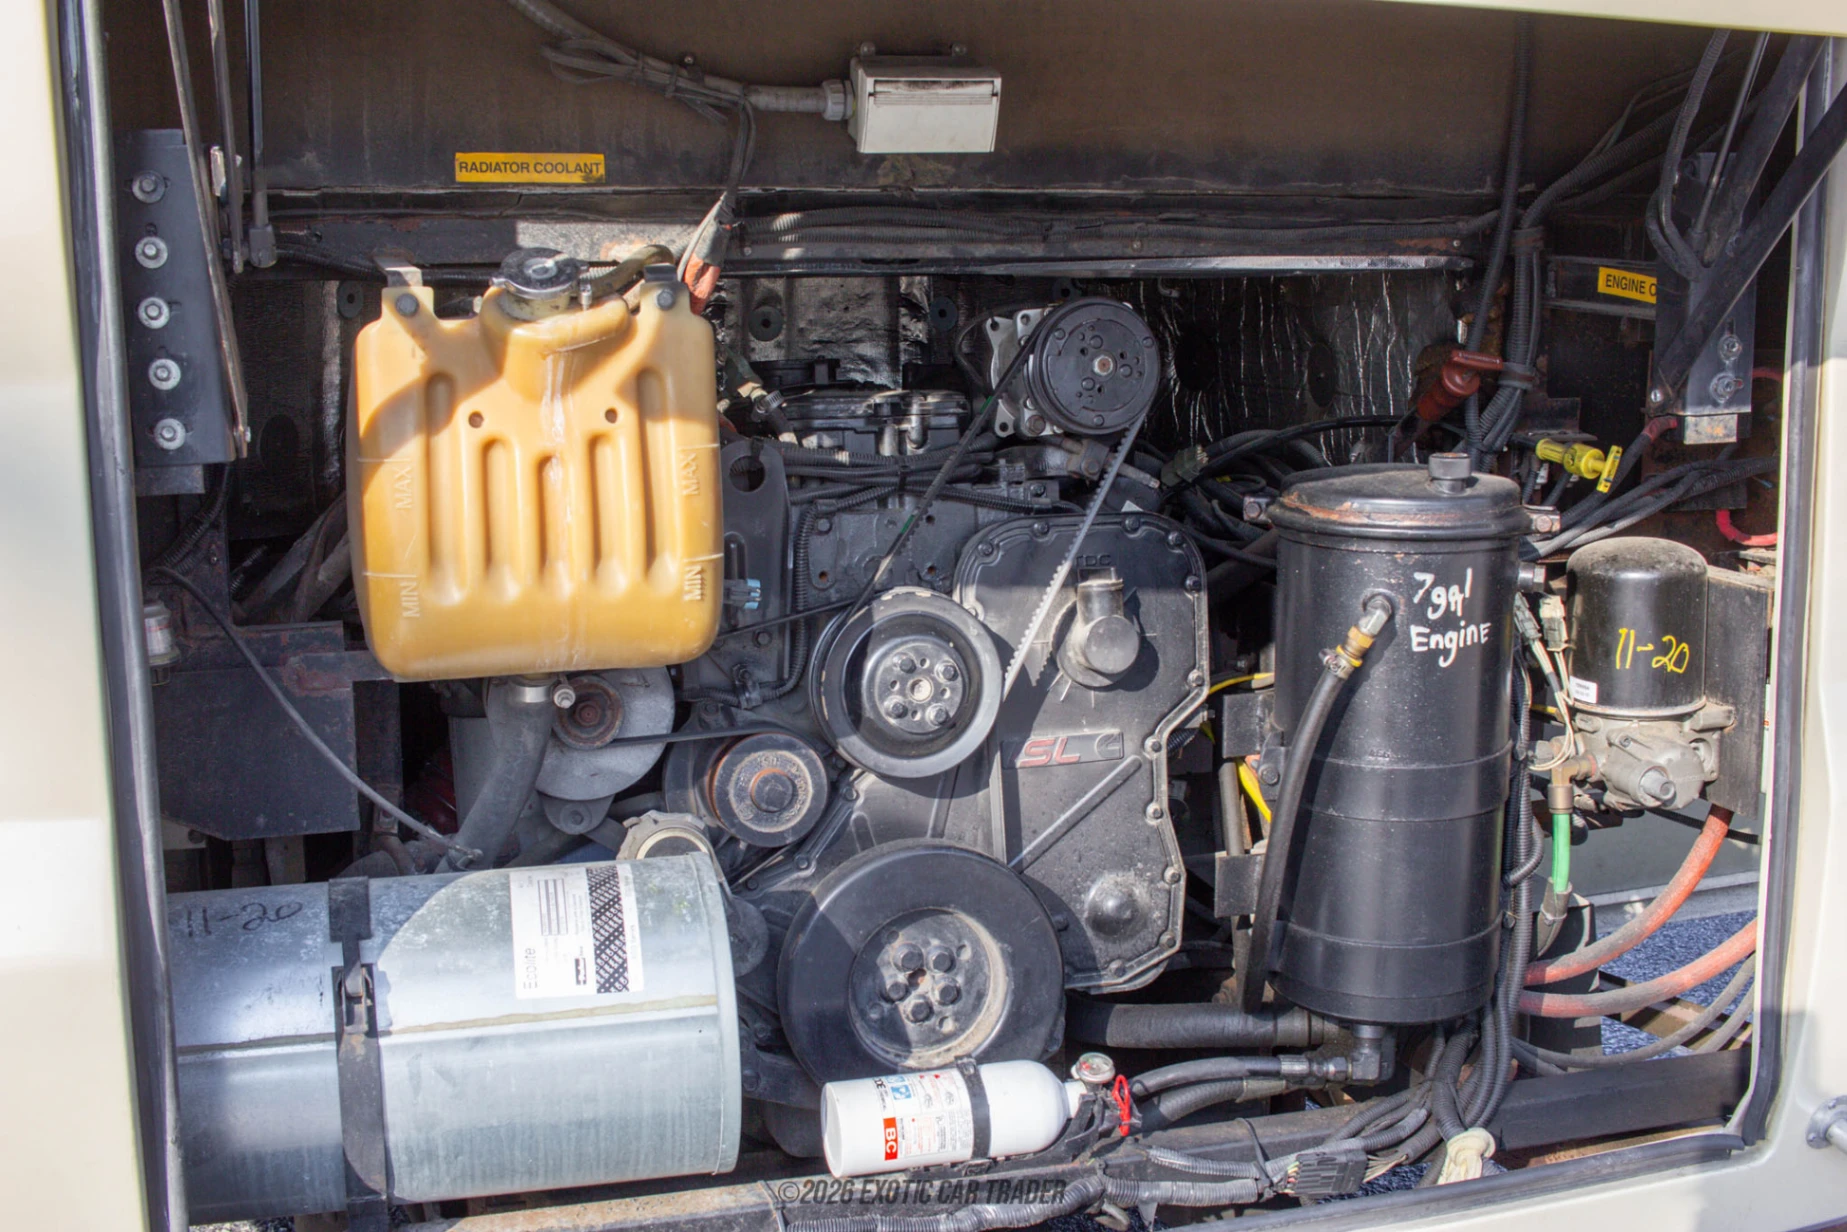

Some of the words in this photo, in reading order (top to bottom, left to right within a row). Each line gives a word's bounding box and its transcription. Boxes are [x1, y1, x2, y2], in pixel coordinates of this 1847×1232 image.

[459, 162, 530, 173] RADIATOR
[533, 161, 602, 175] COOLANT
[1606, 274, 1646, 294] ENGINE
[393, 466, 413, 509] MAX
[680, 452, 701, 496] MAX
[400, 580, 421, 618] MIN
[683, 565, 703, 602] MIN
[1615, 627, 1690, 674] 11-20
[184, 901, 303, 938] 11-20
[885, 1127, 898, 1153] BC
